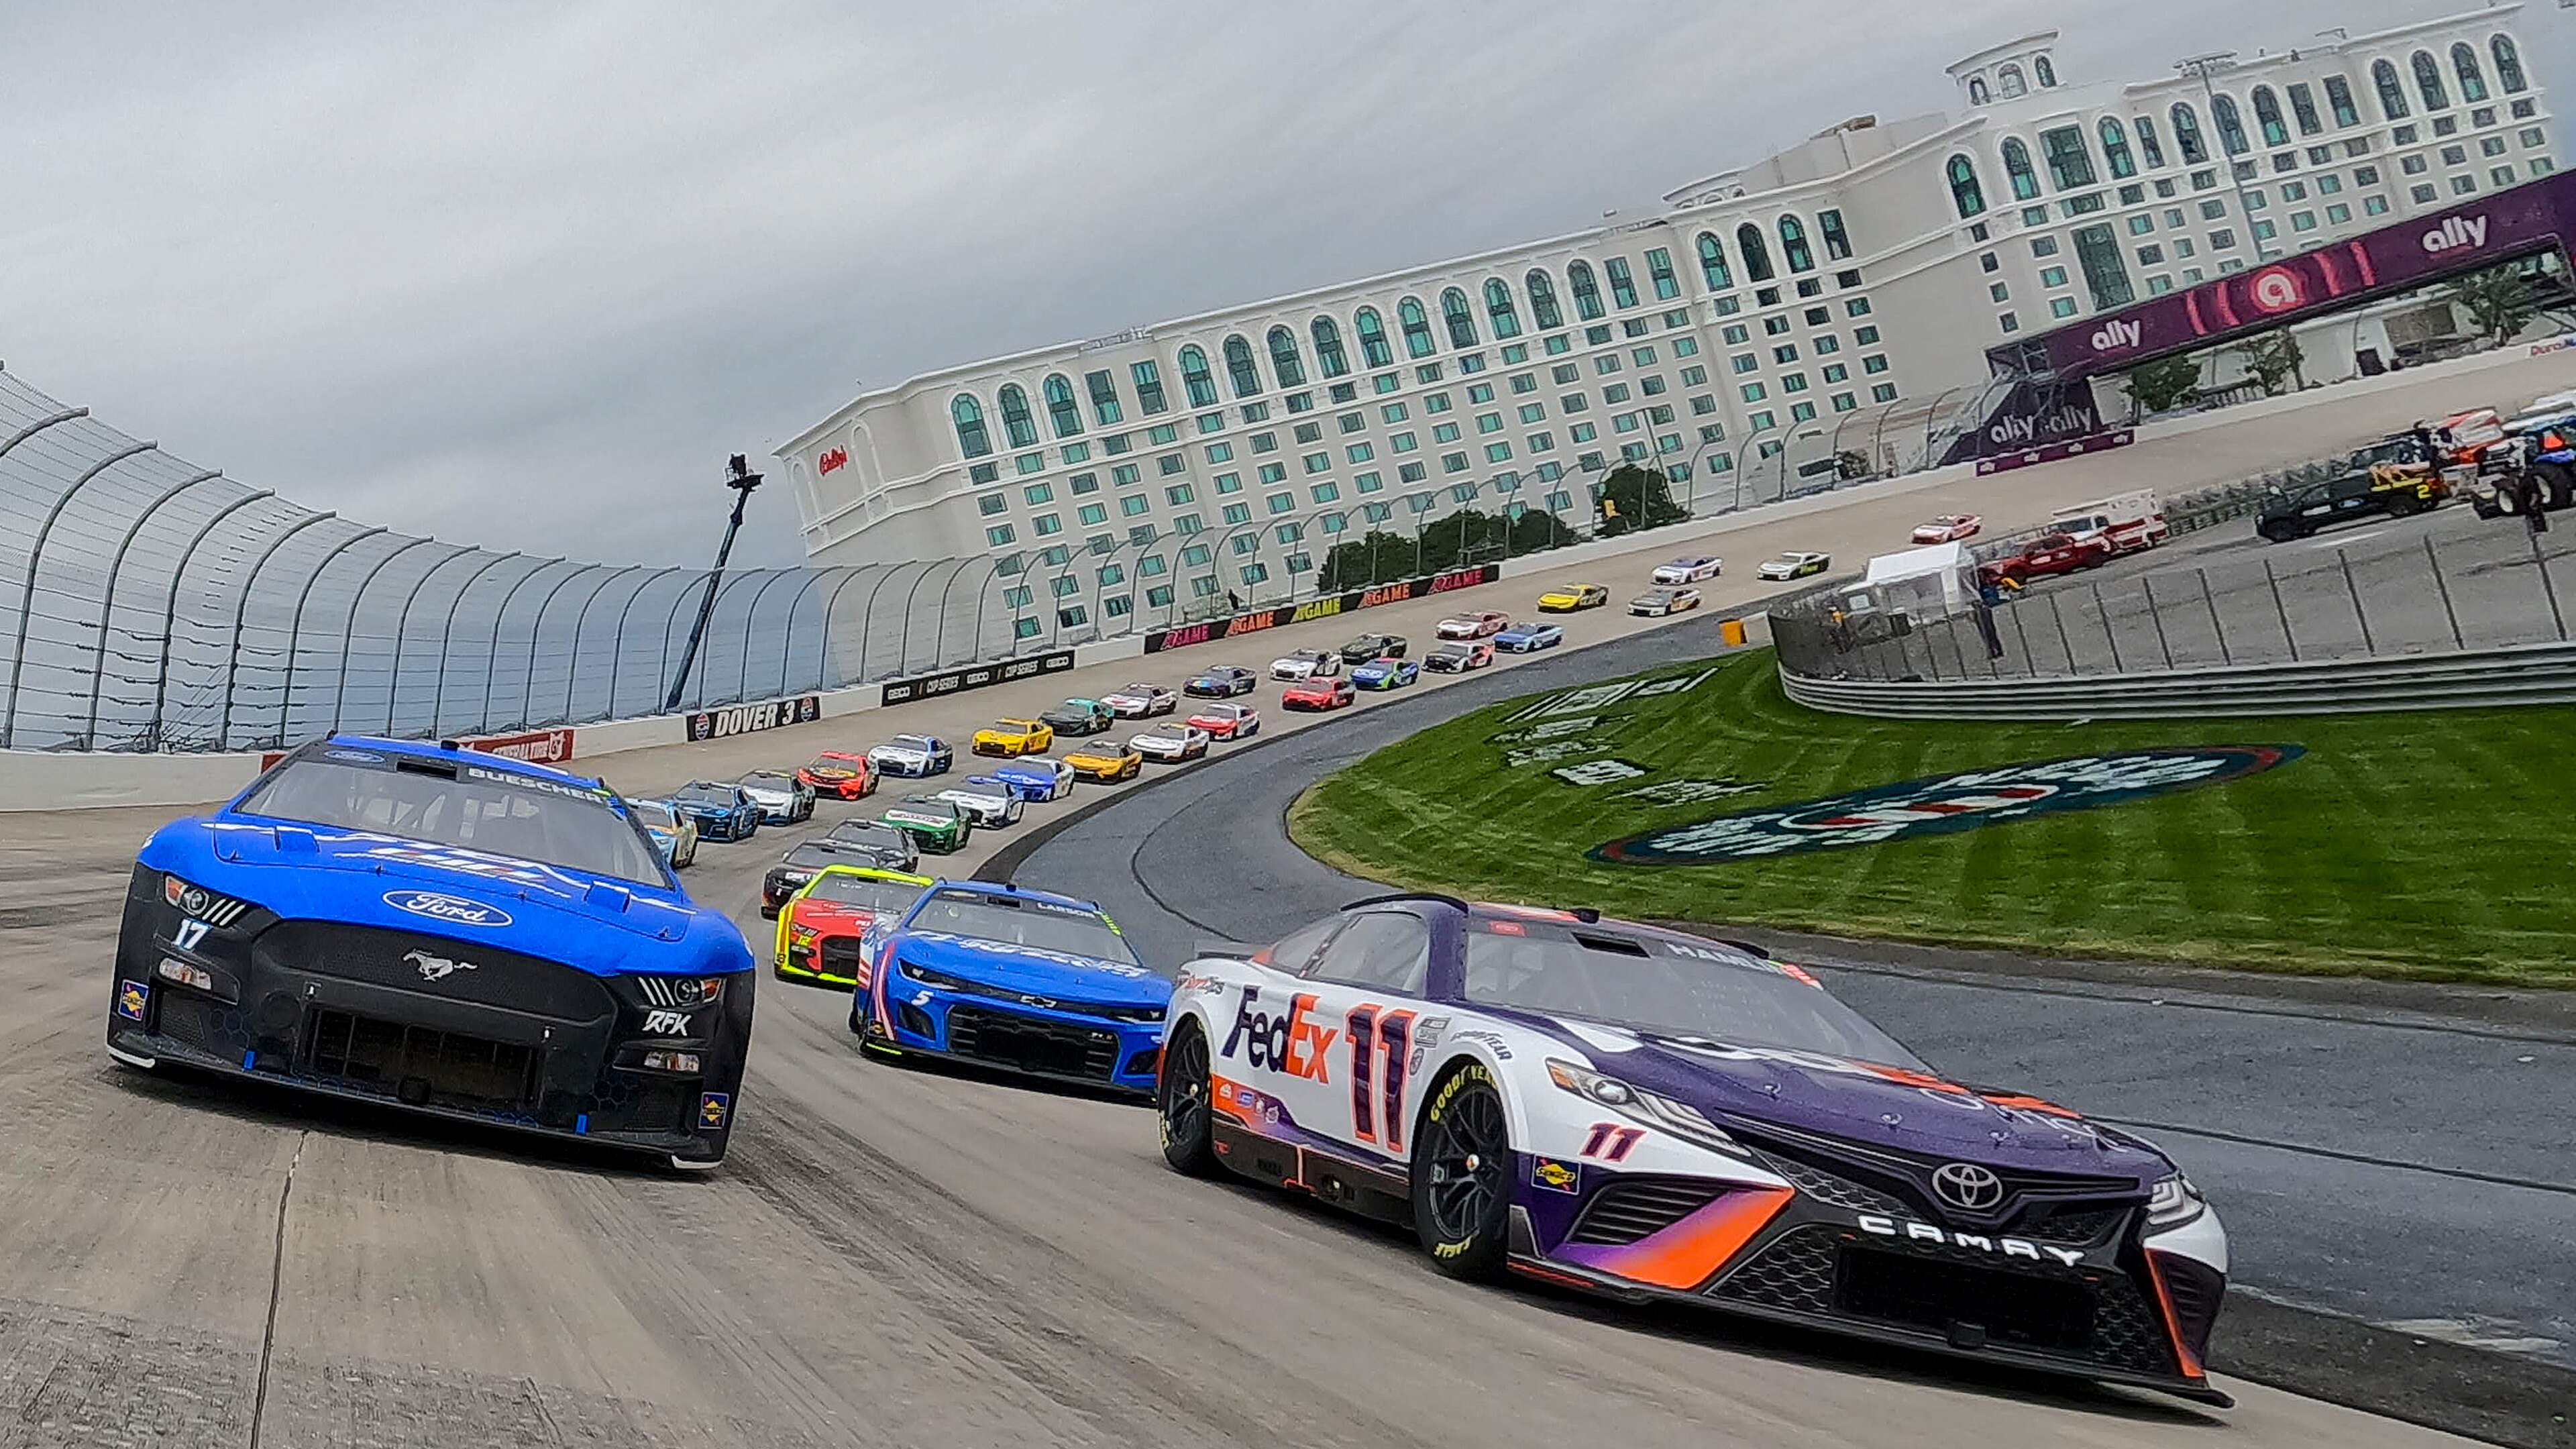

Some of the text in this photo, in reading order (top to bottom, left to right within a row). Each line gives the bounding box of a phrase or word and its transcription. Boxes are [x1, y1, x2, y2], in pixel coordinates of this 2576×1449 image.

[2422, 215, 2487, 252] ally
[2092, 320, 2140, 350] ally
[1990, 414, 2034, 443] ally
[2049, 405, 2092, 433] ally
[1046, 656, 1070, 668] GEICO
[967, 671, 989, 684] GEICO
[888, 686, 910, 700] GEICO
[714, 704, 778, 737] DOVER
[782, 700, 796, 725] 3
[530, 741, 549, 759] TIRE
[469, 767, 604, 804] BUESCHER
[407, 894, 490, 922] Ford
[172, 918, 213, 951] 17
[911, 990, 934, 1007] 5
[642, 1010, 692, 1036] RFK
[1221, 985, 1339, 1085] FedEx
[1344, 1003, 1418, 1153] 11
[1580, 1123, 1648, 1163] 11
[1858, 1215, 2084, 1267] CAMRY
